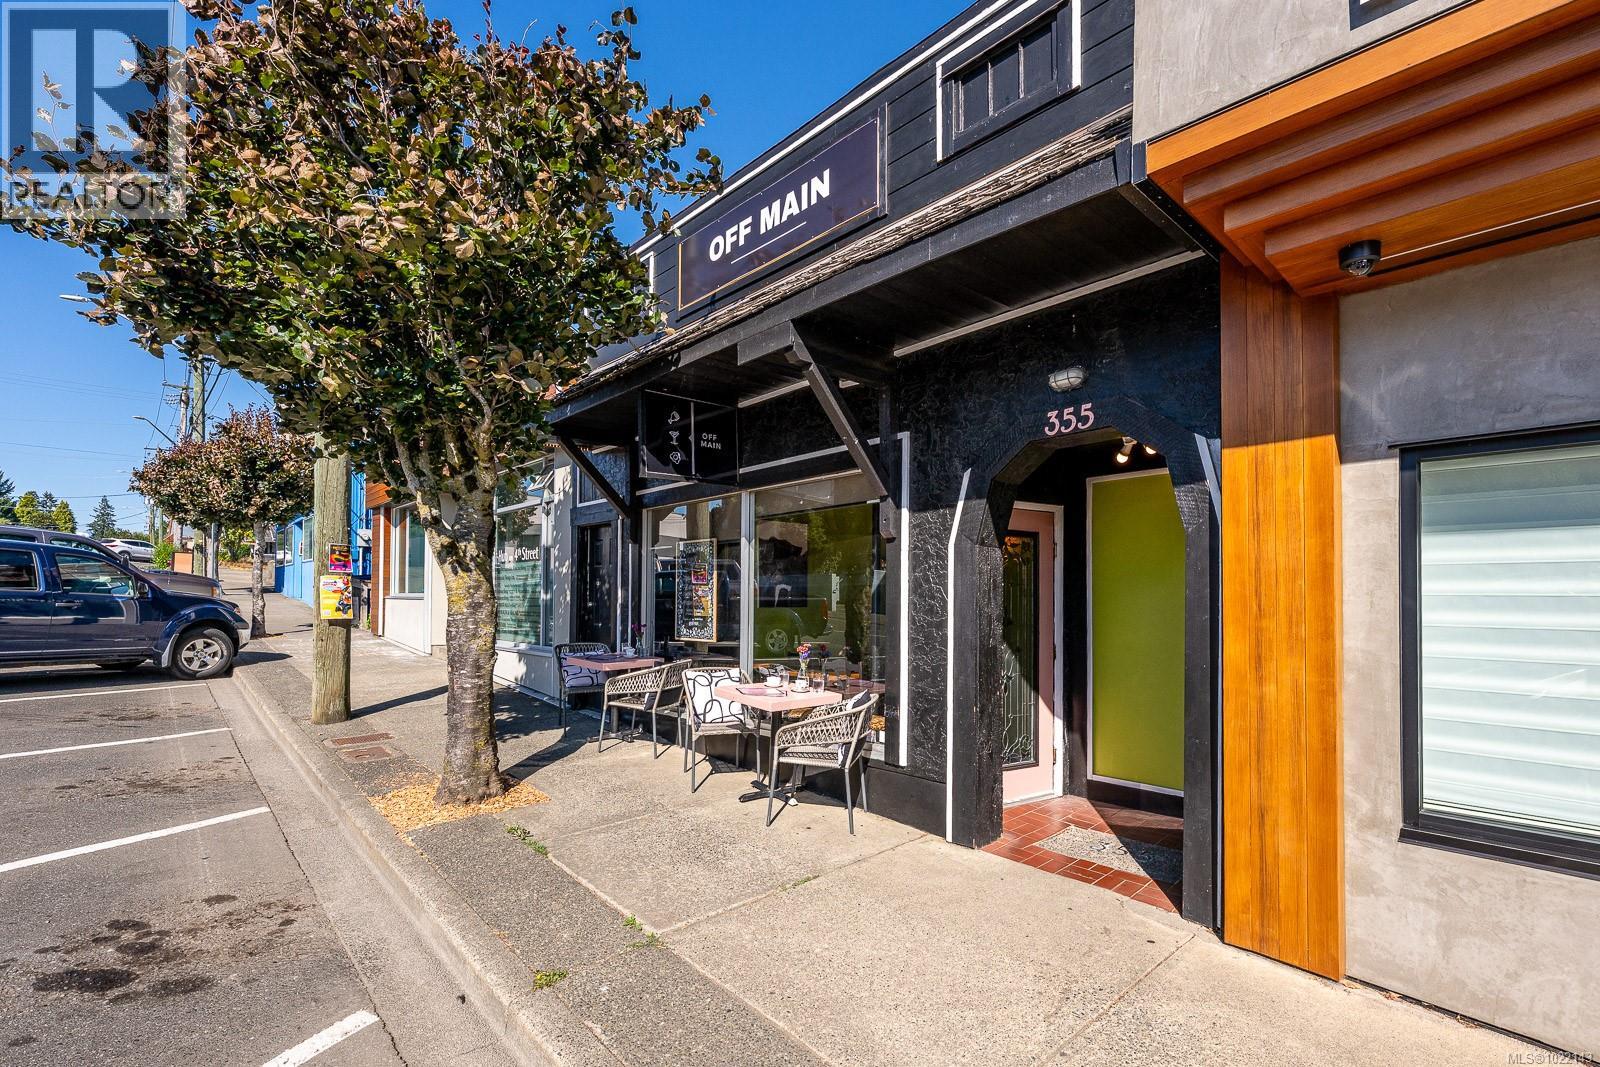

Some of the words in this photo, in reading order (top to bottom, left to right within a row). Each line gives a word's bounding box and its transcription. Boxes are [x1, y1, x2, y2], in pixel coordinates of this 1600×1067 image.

[709, 215, 752, 262] OFF
[760, 168, 830, 235] MAIN
[1044, 402, 1095, 436] 355
[702, 432, 718, 441] OFF
[700, 440, 722, 450] MAIN
[521, 546, 539, 561] Street
